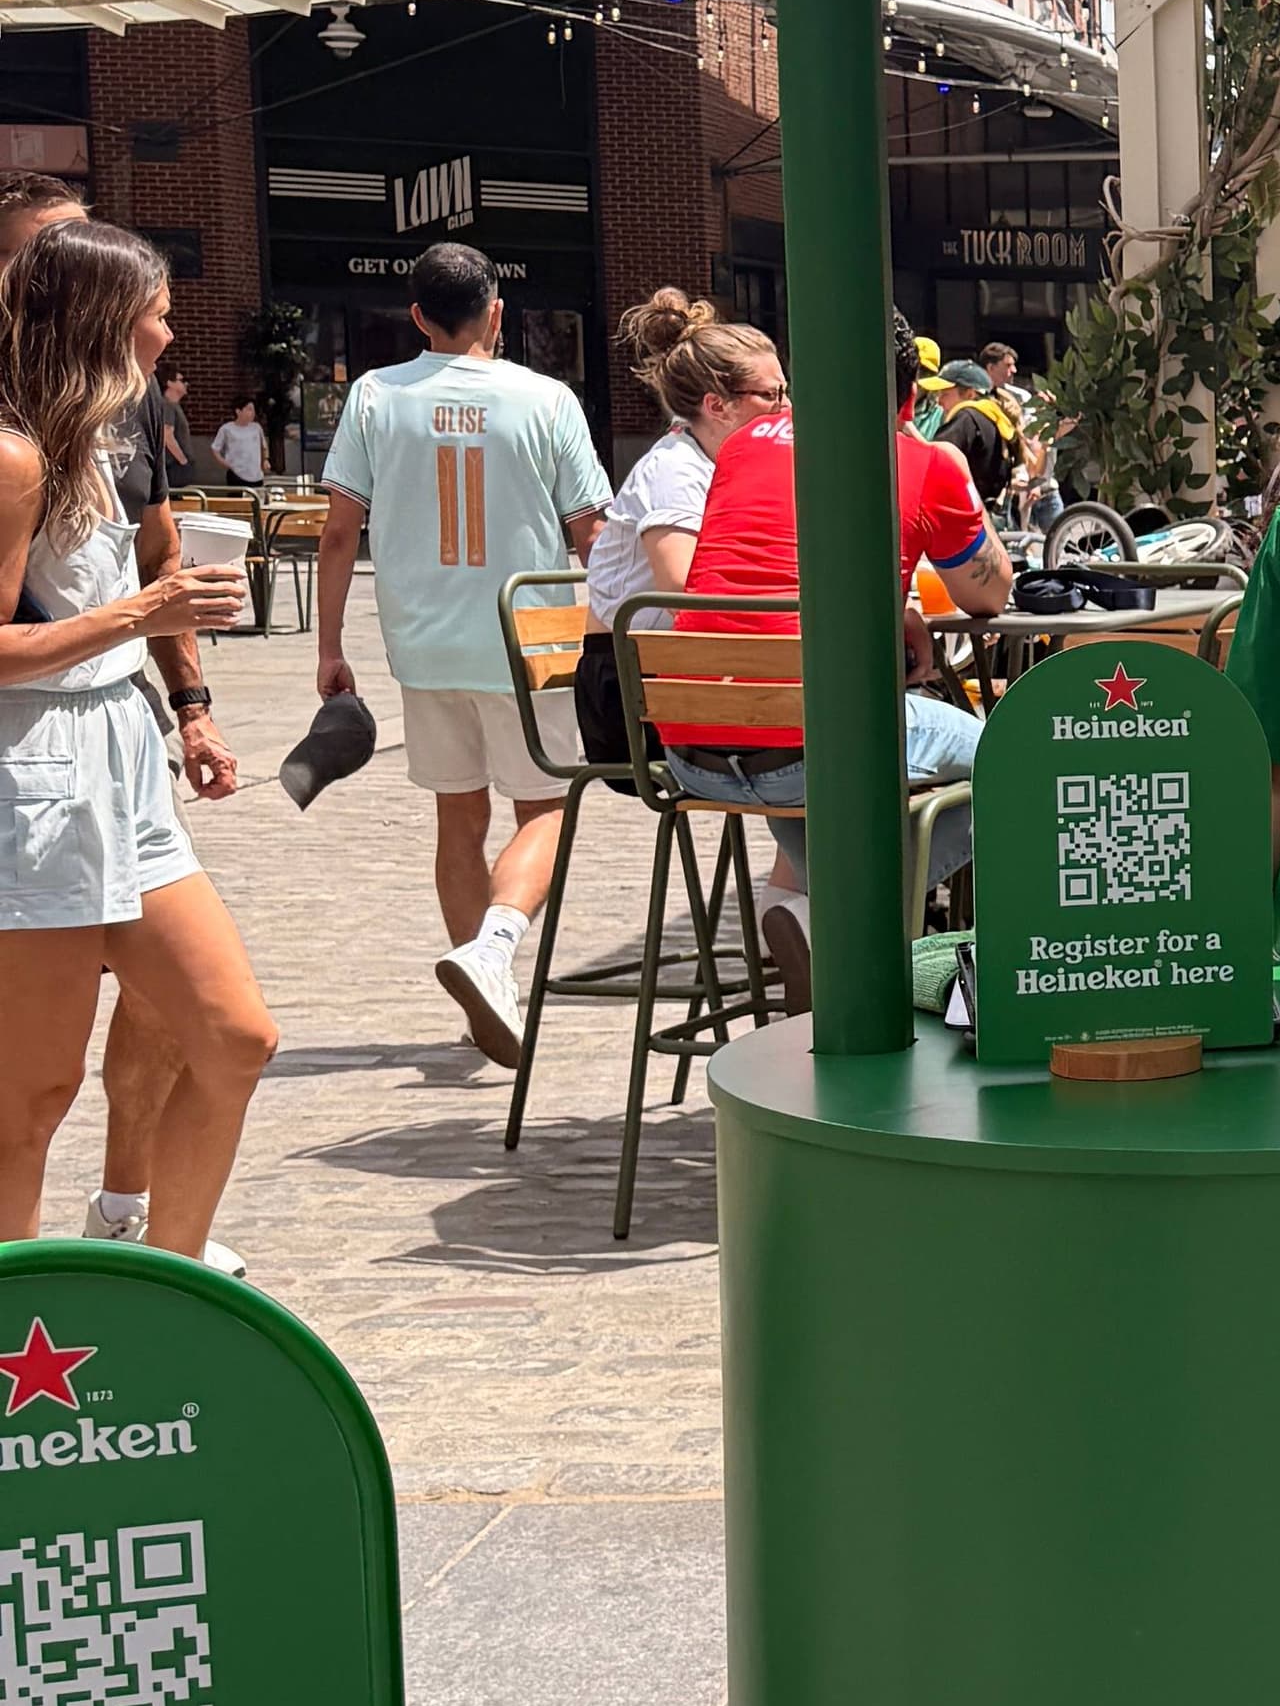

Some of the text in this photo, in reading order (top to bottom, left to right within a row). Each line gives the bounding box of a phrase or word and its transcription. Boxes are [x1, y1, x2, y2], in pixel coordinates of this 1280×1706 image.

[960, 229, 1012, 266] TUCK
[1017, 231, 1086, 267] ROOM
[348, 257, 388, 275] GET
[434, 406, 487, 434] OLISE
[437, 446, 486, 566] 11
[1029, 929, 1221, 964] Register for a
[1170, 962, 1234, 985] here
[86, 1390, 114, 1403] 1873
